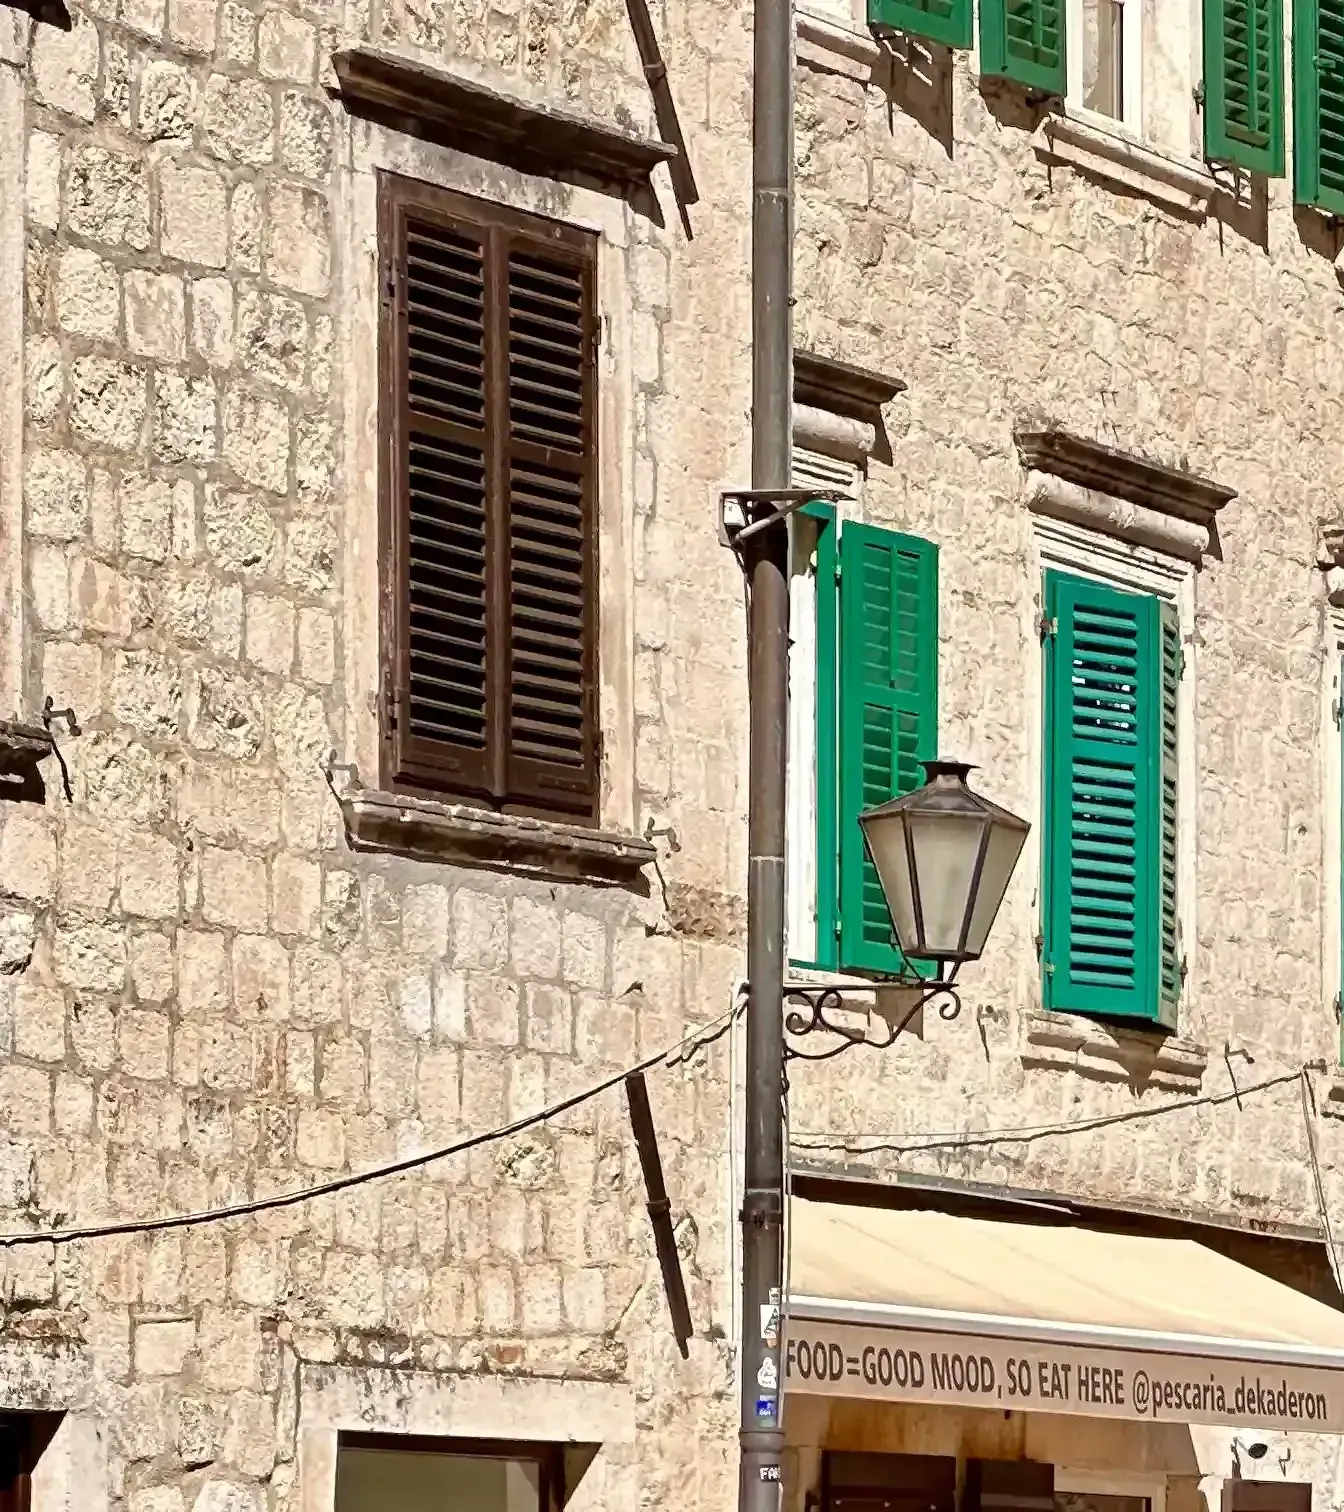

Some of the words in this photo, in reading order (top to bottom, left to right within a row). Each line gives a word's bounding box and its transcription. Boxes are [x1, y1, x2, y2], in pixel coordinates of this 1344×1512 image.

[785, 1338, 925, 1389] FOOD=GOOD
[931, 1352, 1002, 1400] MOOD,
[1006, 1357, 1032, 1396] SO
[1038, 1361, 1072, 1401] EAT
[1078, 1364, 1125, 1405] HERE
[1132, 1369, 1328, 1420] @pescaria_dekaderon
